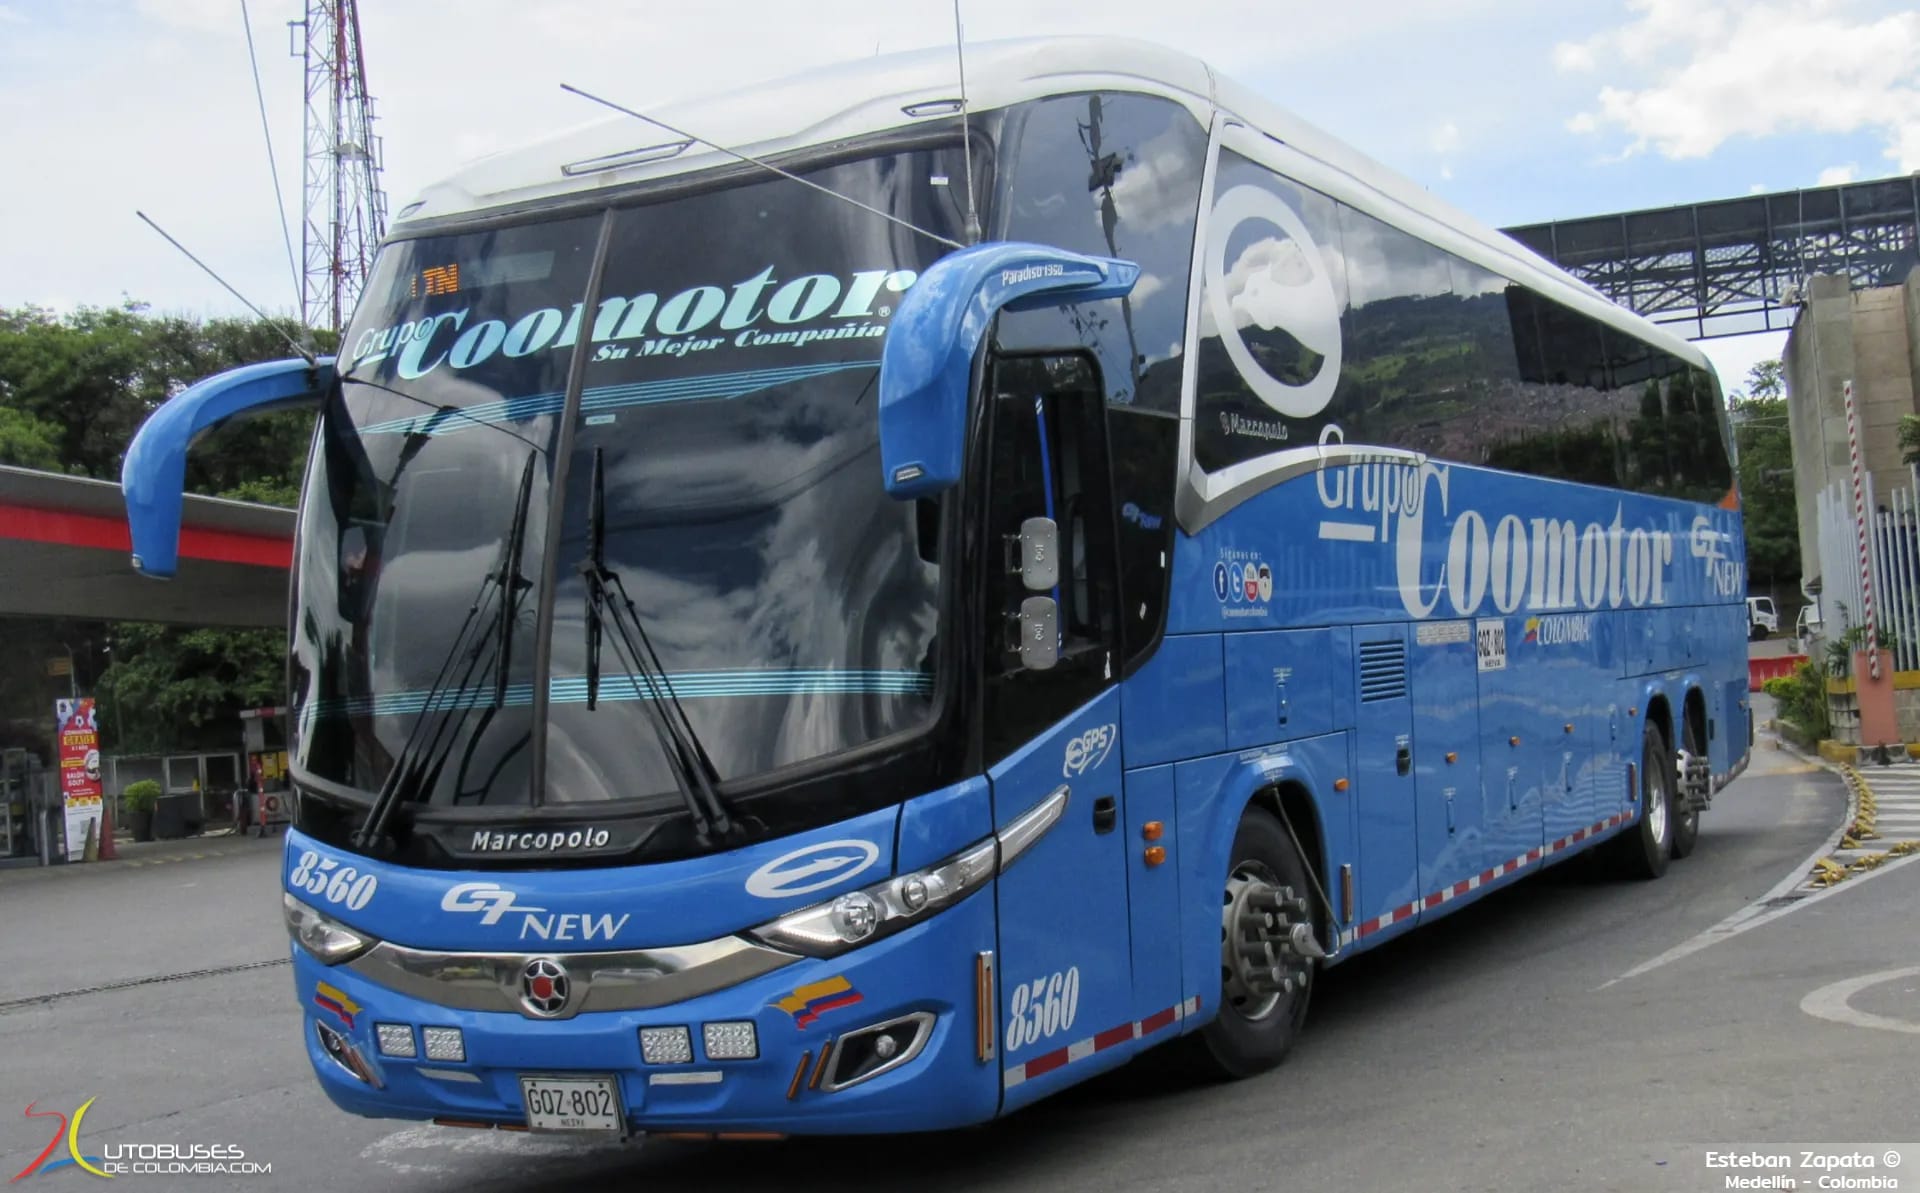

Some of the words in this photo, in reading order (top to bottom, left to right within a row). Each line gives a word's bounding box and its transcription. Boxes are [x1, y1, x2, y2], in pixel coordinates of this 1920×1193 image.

[1002, 263, 1042, 287] Paradiso
[353, 316, 436, 361] Grupo
[397, 264, 917, 380] Coomotor
[592, 343, 628, 362] Su
[636, 335, 725, 358] Mejor
[734, 321, 887, 348] Compañía
[1229, 412, 1288, 441] Marcopolo
[1316, 424, 1420, 543] Grupo
[1396, 462, 1673, 619] Coomotor
[1713, 561, 1744, 596] NEW
[1537, 615, 1591, 646] COLOMBIA
[471, 827, 609, 851] Marcopolo
[291, 851, 378, 911] 8560
[519, 913, 630, 941] NEW
[1006, 966, 1080, 1051] 8560
